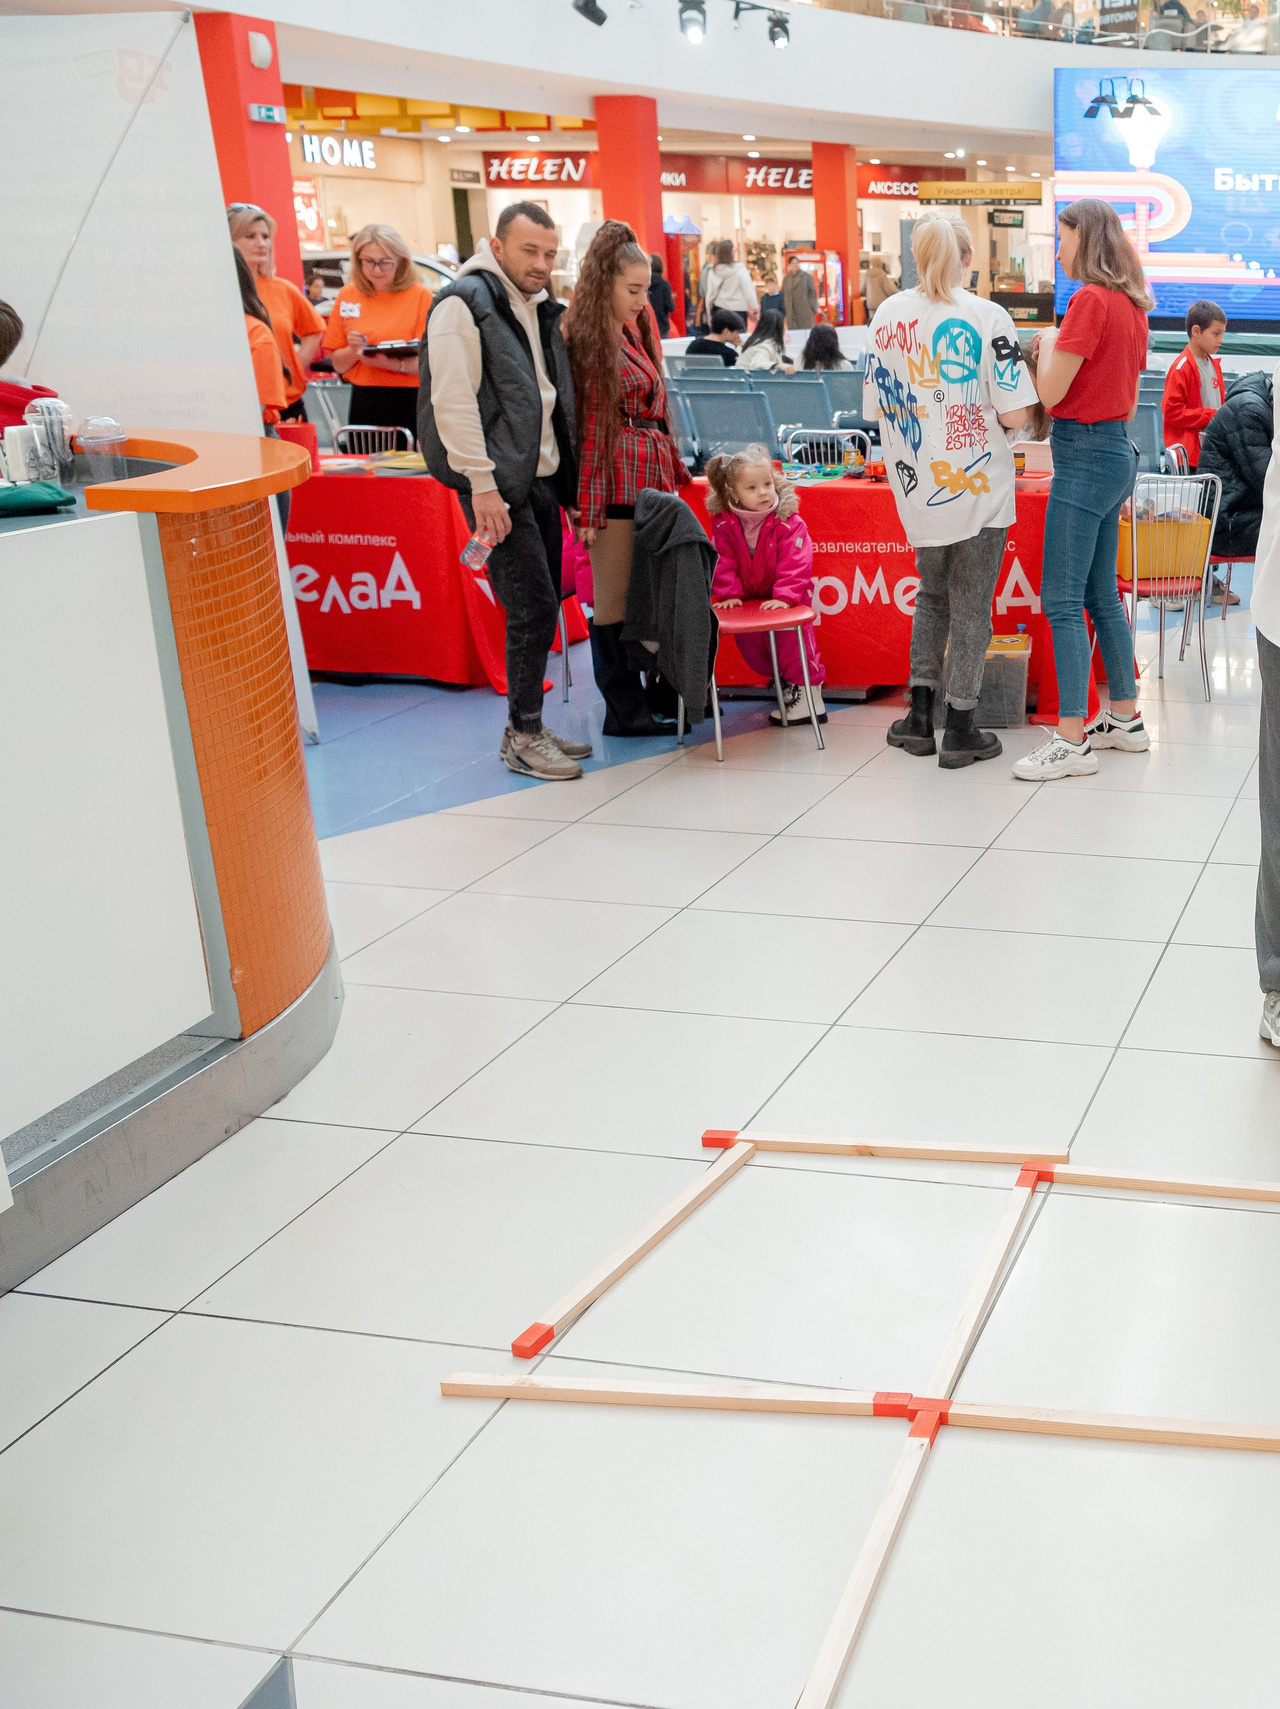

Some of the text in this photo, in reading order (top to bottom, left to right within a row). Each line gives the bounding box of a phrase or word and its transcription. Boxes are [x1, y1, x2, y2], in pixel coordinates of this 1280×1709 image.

[302, 134, 376, 169] HOME
[489, 157, 587, 181] HELEN
[868, 181, 919, 195] АКСЕСС
[328, 533, 397, 547] комплекс
